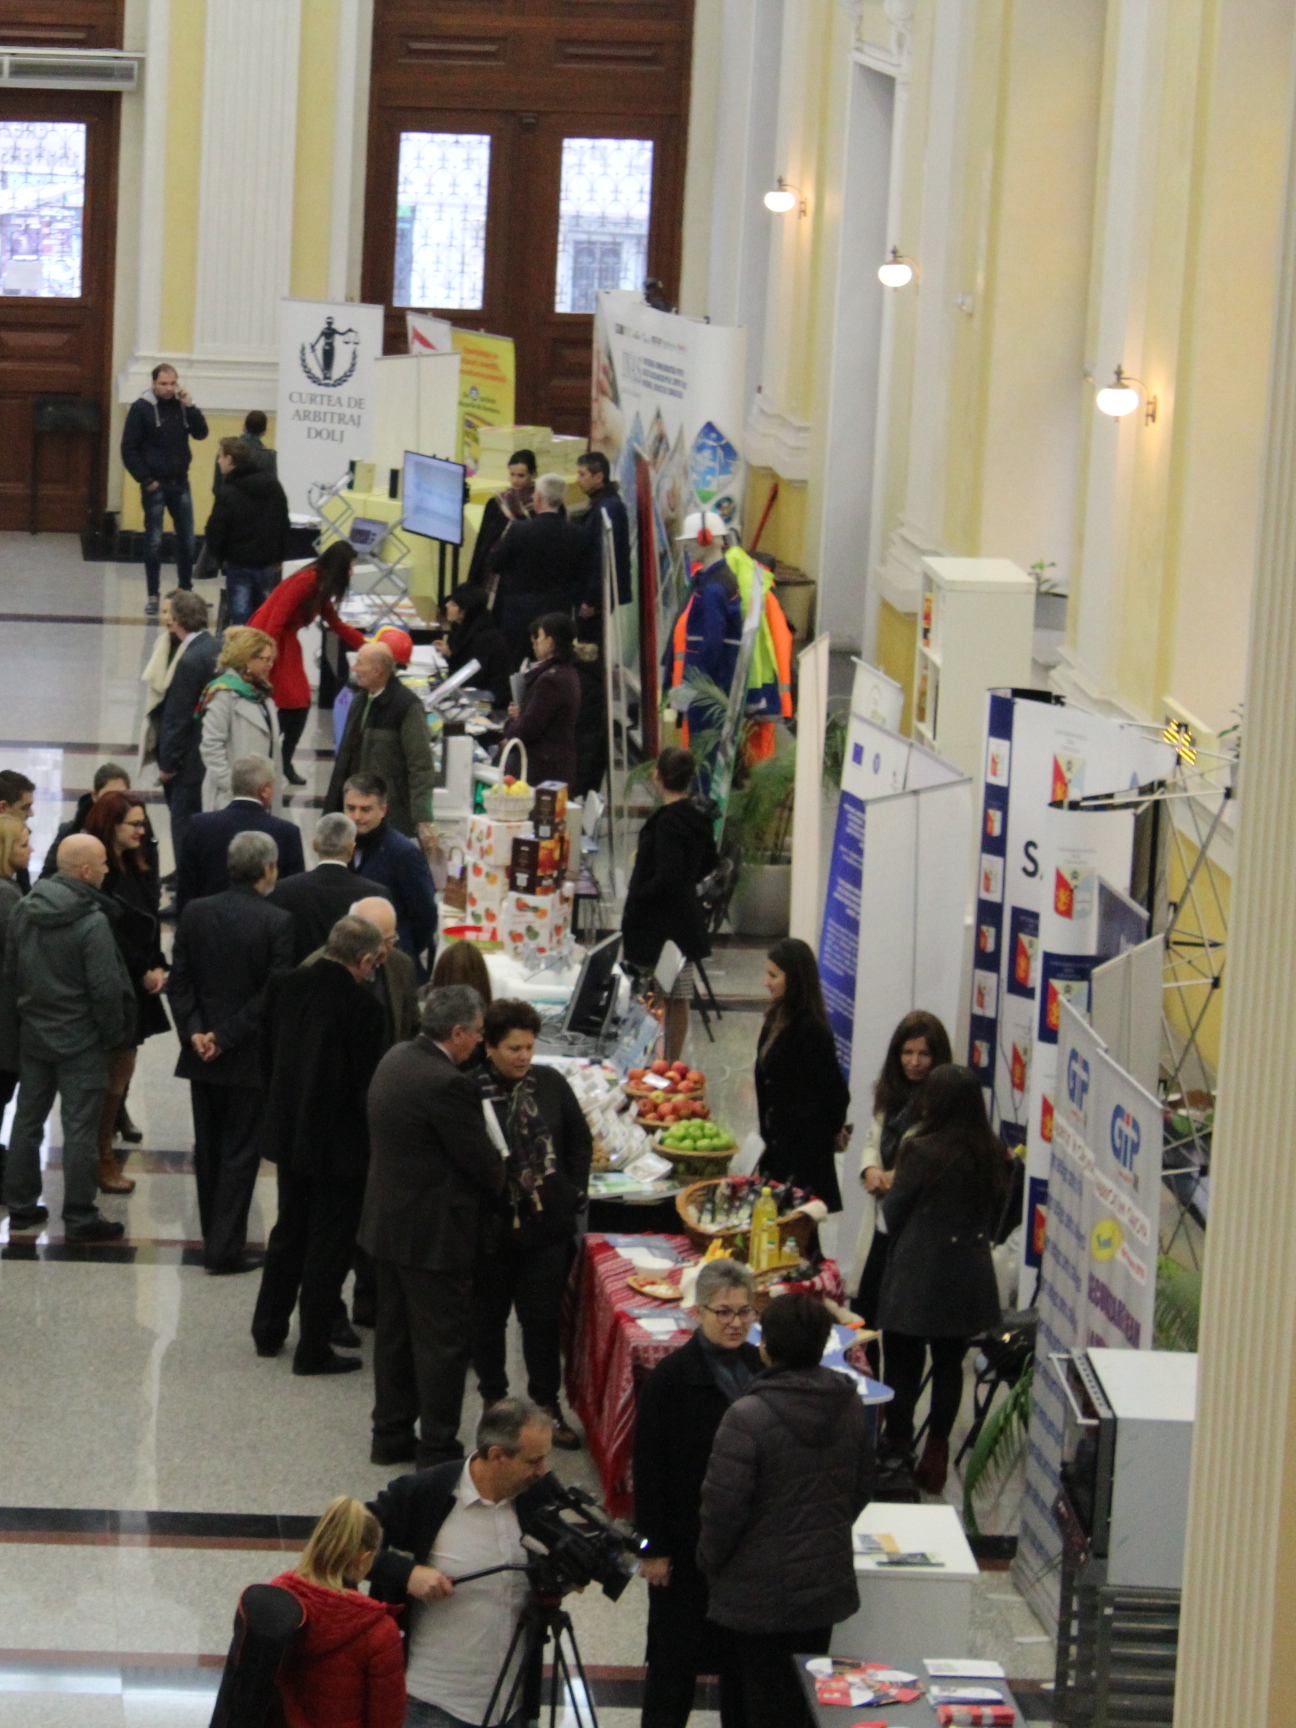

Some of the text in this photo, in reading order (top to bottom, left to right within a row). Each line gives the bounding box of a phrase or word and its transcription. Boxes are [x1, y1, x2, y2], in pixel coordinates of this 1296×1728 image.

[289, 391, 366, 410] CURTEA DE
[292, 409, 362, 429] ARBITRAJ
[306, 427, 345, 443] DOLJ
